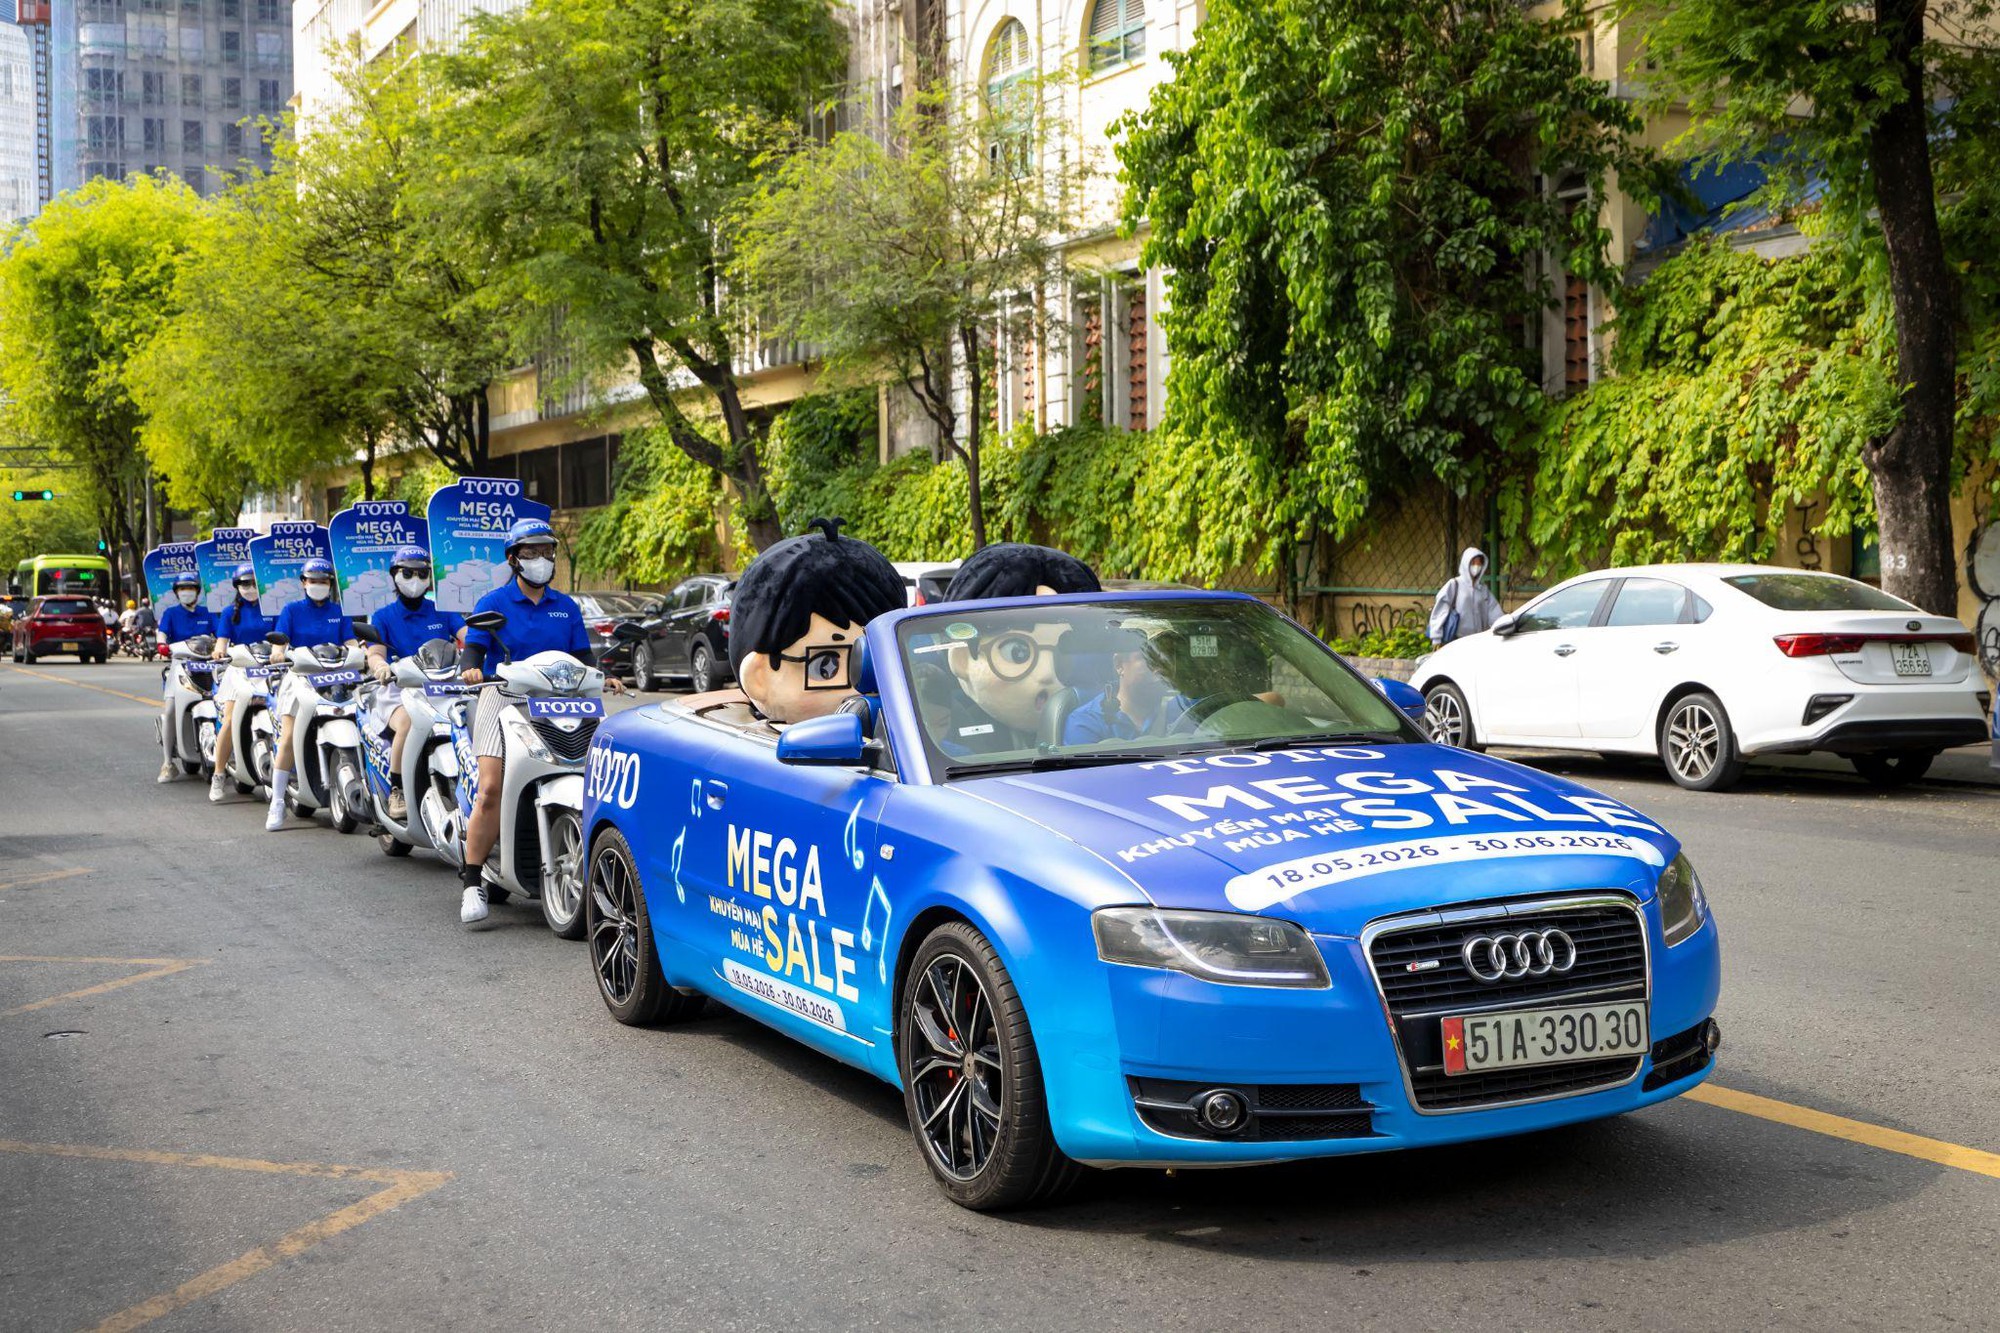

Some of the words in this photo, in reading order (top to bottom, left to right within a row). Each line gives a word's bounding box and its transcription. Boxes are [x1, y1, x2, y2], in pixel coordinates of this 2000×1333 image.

[462, 481, 520, 496] TOTO
[357, 503, 406, 516] TOTO
[460, 501, 516, 517] MEGA
[273, 524, 315, 534] TOTO
[356, 520, 404, 534] MEGA
[480, 516, 511, 531] SAL
[215, 530, 253, 539] TOTO
[374, 531, 416, 545] SALE
[161, 544, 194, 555] TOTO
[274, 538, 315, 549] MEGA
[230, 551, 251, 561] SAL
[289, 547, 324, 558] SALE
[403, 548, 429, 557] TOTO
[161, 556, 194, 566] MEGA
[548, 611, 569, 619] TOTO
[313, 671, 356, 684] TOTO
[535, 701, 597, 714] TOTO
[1138, 748, 1386, 775] TOTO
[587, 747, 641, 810] TOTO
[1146, 769, 1531, 822] MEGA
[1340, 792, 1665, 836] SALE
[1116, 818, 1263, 863] KHUYẾN
[1268, 807, 1341, 826] MẠI
[1223, 830, 1311, 853] MÙA
[1312, 818, 1365, 836] HÈ
[727, 823, 827, 917] MEGA
[1266, 844, 1439, 889] 18.05.2026
[1468, 836, 1633, 852] 30.06.2026
[709, 894, 744, 923] KHUYẾN
[744, 907, 762, 933] MẠI
[730, 927, 751, 953] MÙA
[751, 934, 765, 959] HÈ
[761, 904, 859, 1003] SALE
[732, 968, 775, 999] 18.05.2026
[782, 989, 834, 1024] 30.06.2026
[1470, 1008, 1641, 1063] 51A-330.30
